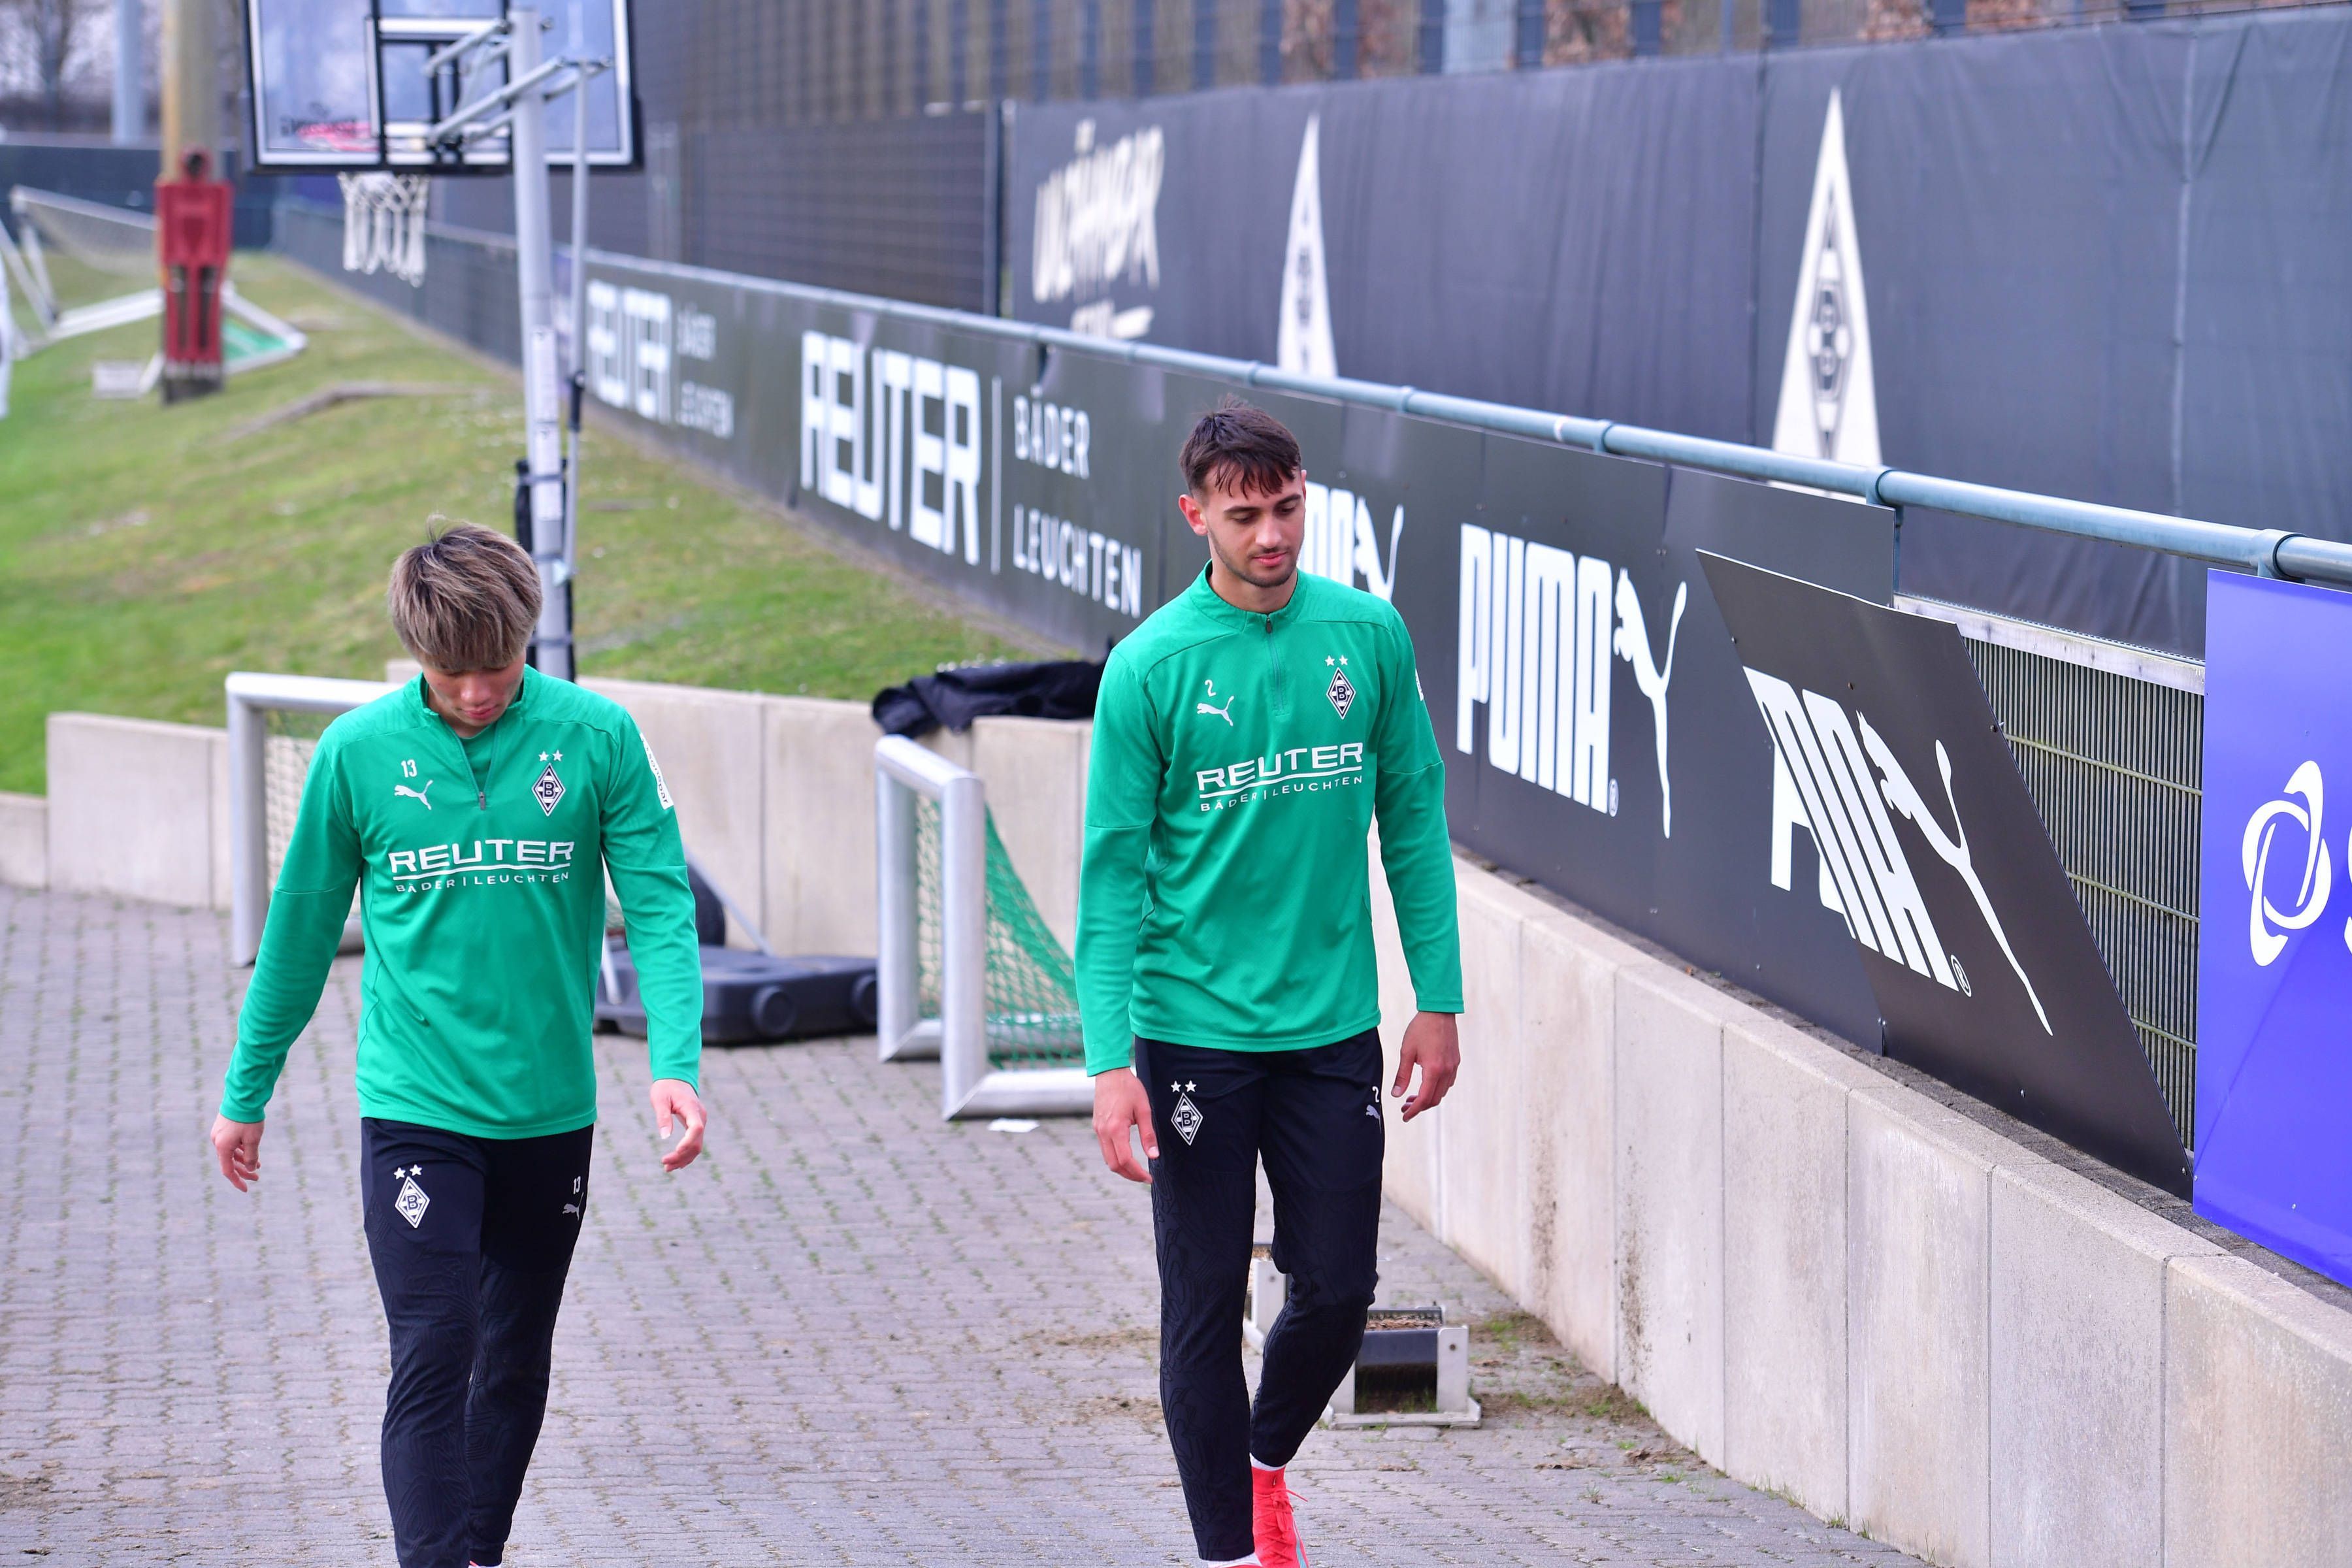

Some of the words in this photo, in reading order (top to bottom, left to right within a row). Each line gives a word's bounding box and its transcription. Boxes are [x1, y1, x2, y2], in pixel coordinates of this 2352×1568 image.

[800, 330, 982, 566] REUTER
[1014, 383, 1090, 480] BÄDER
[1013, 503, 1142, 618] LEUCHTEN
[1205, 679, 1216, 697] 2
[400, 759, 418, 778] 13
[1196, 742, 1364, 791] REUTER
[1200, 793, 1258, 812] BÄDER
[1272, 775, 1363, 796] LEUCHTEN
[1742, 666, 1960, 993] MA
[388, 839, 575, 874] REUTER
[474, 872, 570, 887] LEUCHTEN
[573, 1176, 581, 1195] 13
